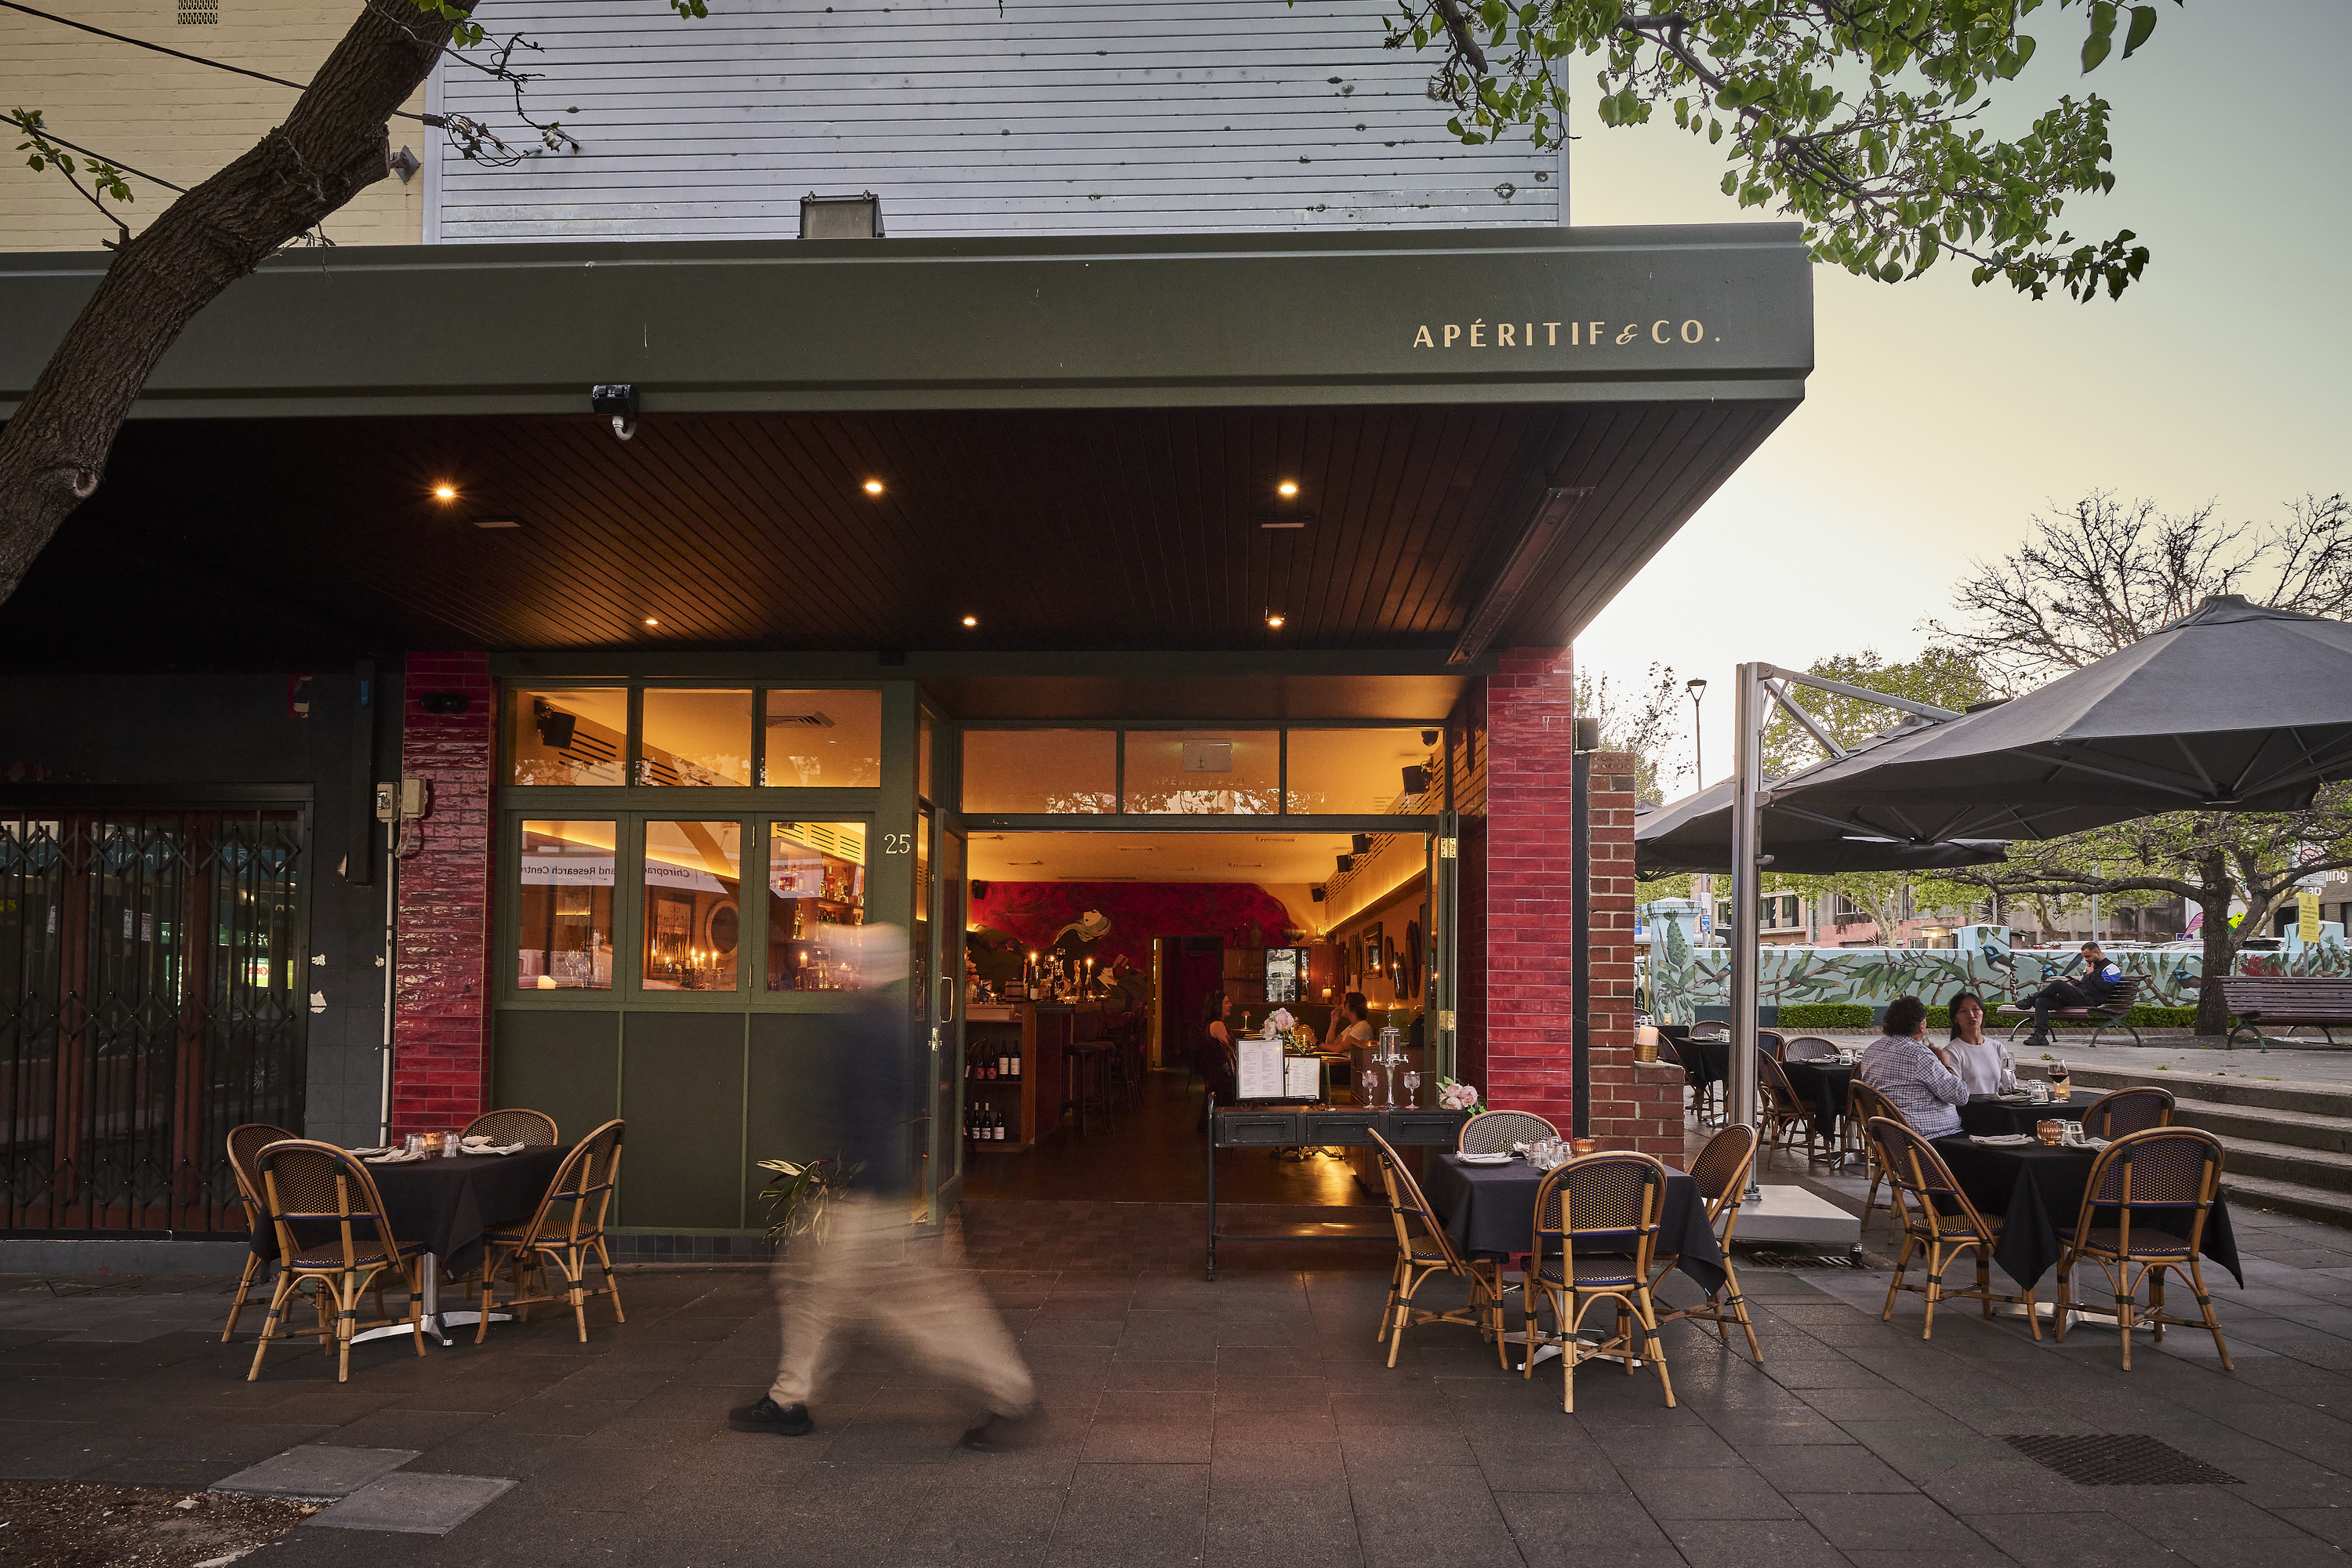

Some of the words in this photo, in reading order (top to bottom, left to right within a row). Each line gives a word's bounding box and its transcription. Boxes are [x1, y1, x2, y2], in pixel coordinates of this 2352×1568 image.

[1413, 318, 1606, 348] APÉRITIF
[1651, 319, 1721, 344] CO.
[884, 833, 911, 855] 25
